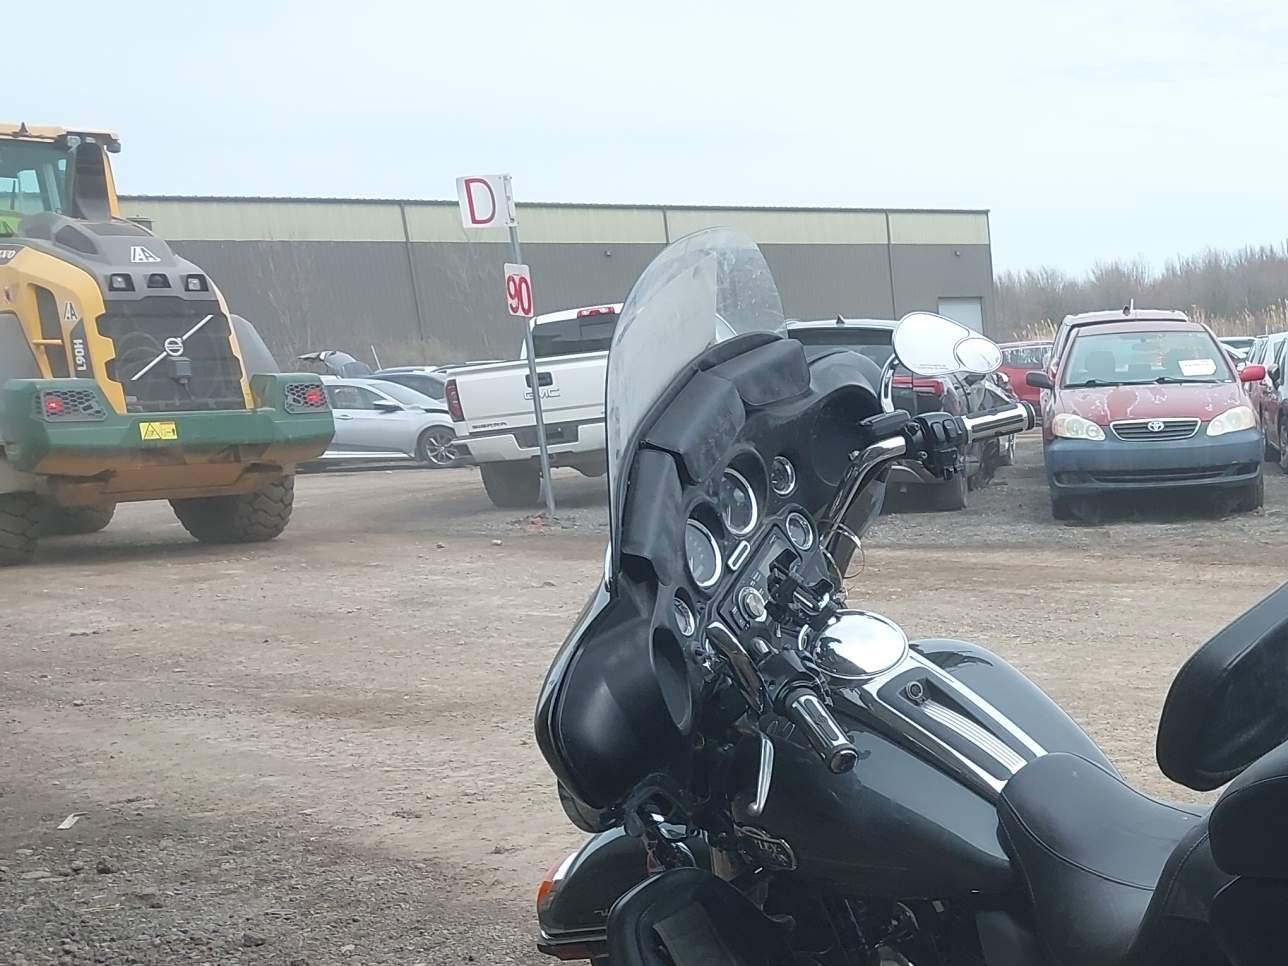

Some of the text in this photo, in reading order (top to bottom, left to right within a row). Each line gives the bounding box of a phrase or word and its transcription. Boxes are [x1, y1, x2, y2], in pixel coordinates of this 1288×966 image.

[464, 178, 496, 225] D
[506, 275, 532, 316] 90
[73, 339, 87, 371] L90H
